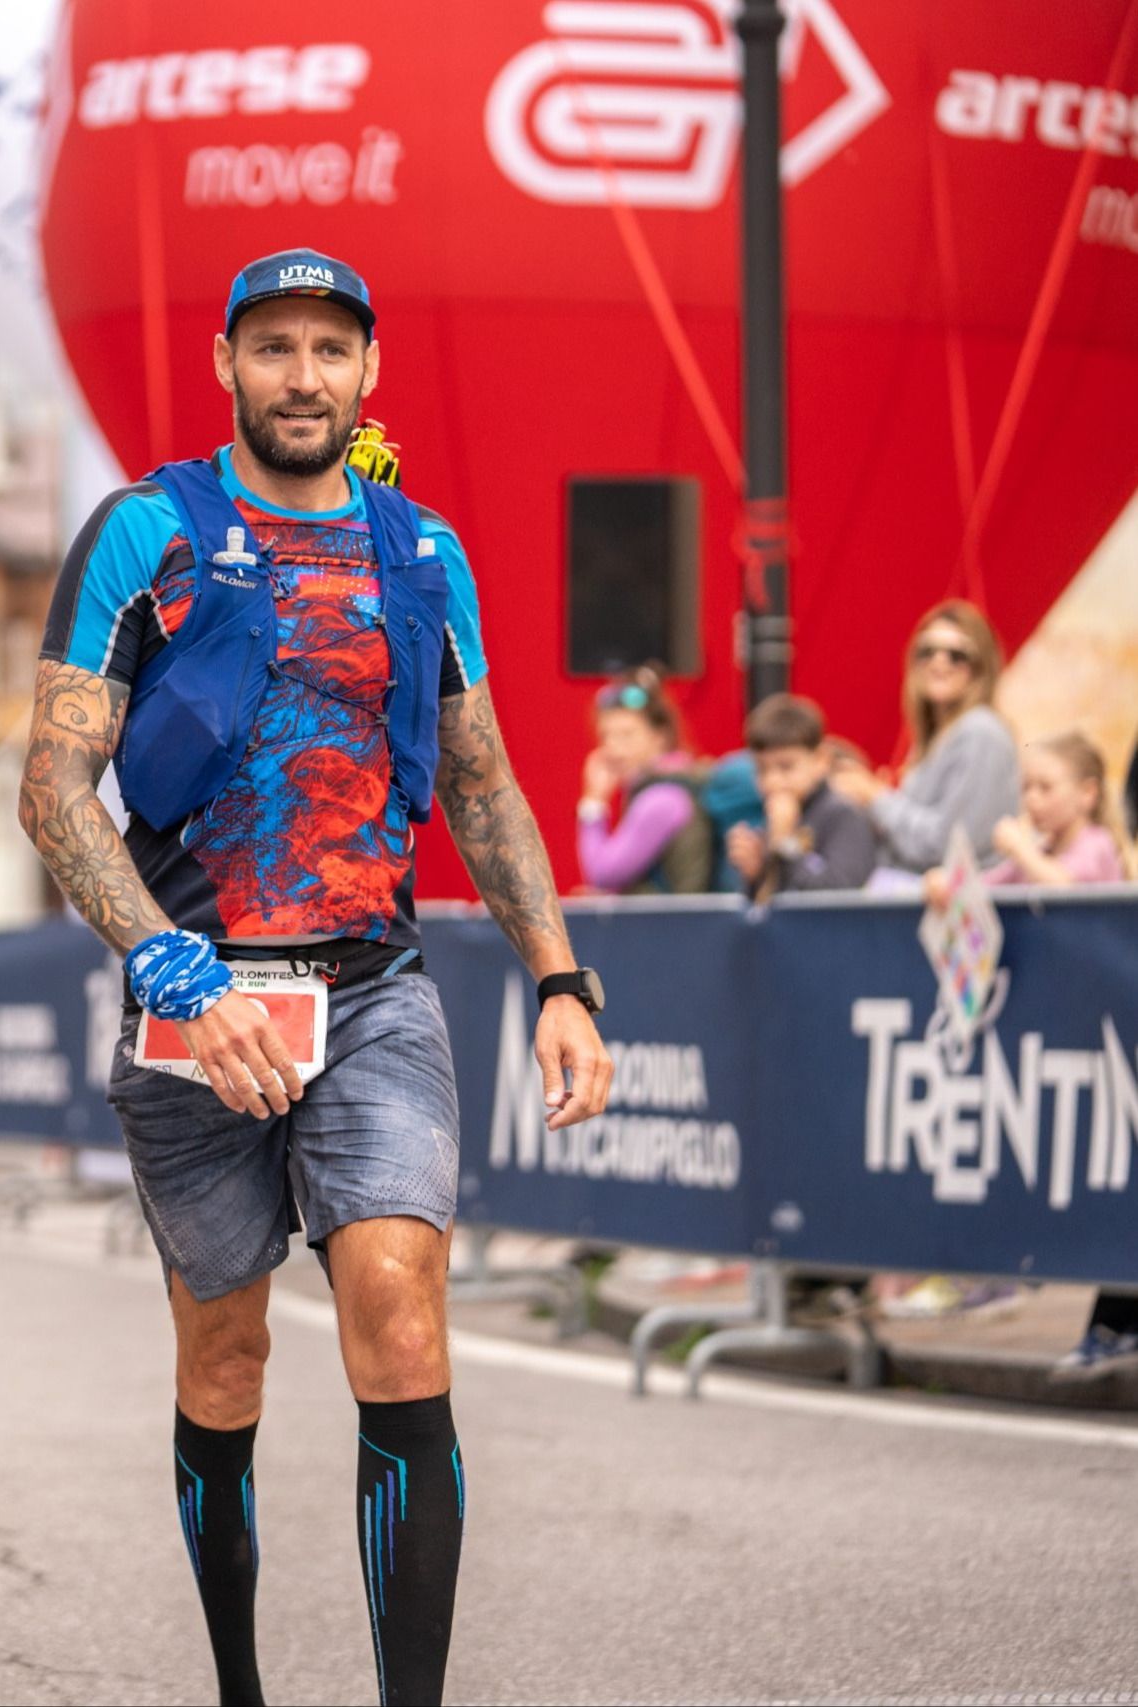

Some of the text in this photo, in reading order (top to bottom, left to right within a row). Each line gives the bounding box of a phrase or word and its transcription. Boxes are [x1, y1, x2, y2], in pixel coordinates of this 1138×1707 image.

[79, 43, 370, 129] arcese
[935, 69, 1138, 160] arce
[184, 126, 403, 208] move it
[279, 265, 335, 284] UTMB
[211, 571, 258, 590] SALOMON
[231, 969, 294, 980] OLOMITES
